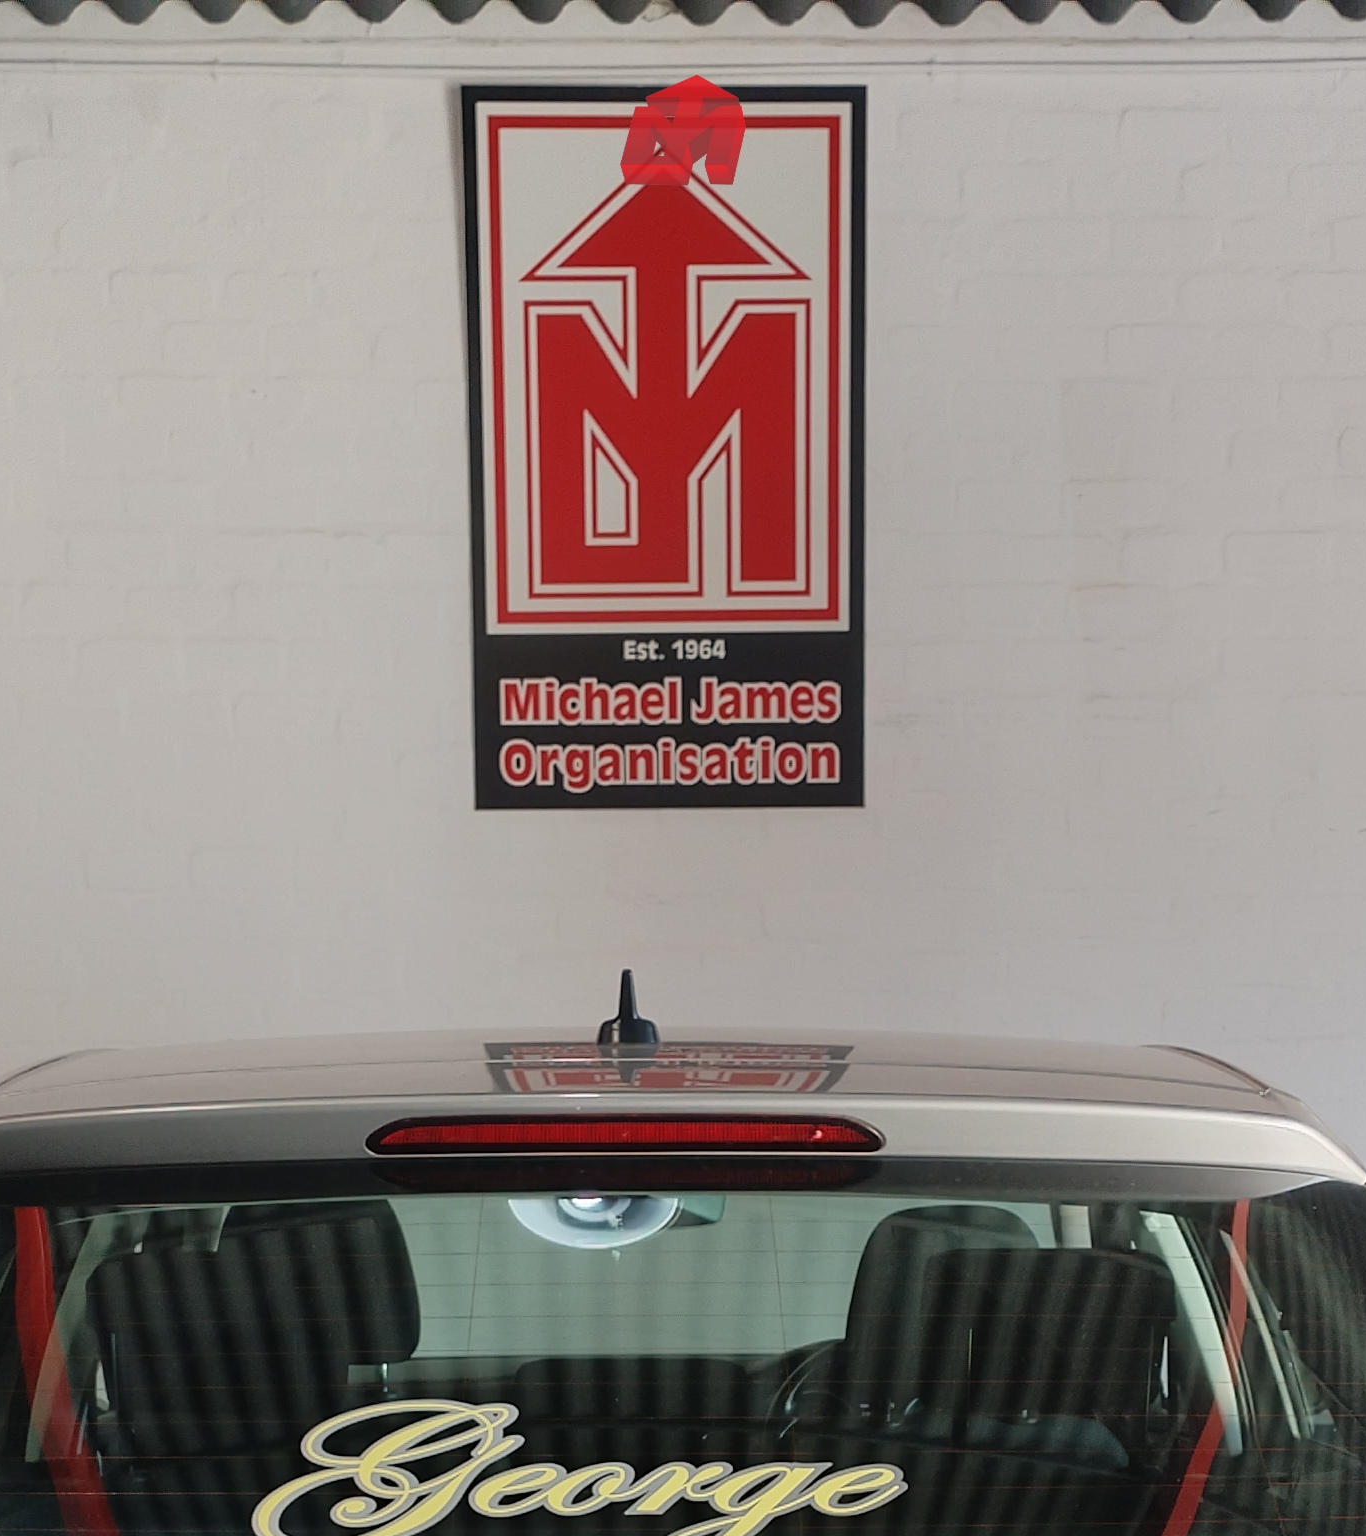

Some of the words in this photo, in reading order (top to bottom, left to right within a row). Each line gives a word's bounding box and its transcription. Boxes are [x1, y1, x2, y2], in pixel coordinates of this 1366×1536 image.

[622, 639, 665, 662] Est.
[671, 639, 727, 662] 1964
[499, 677, 682, 725] Michael
[690, 677, 842, 724] James
[499, 737, 842, 793] Organisation
